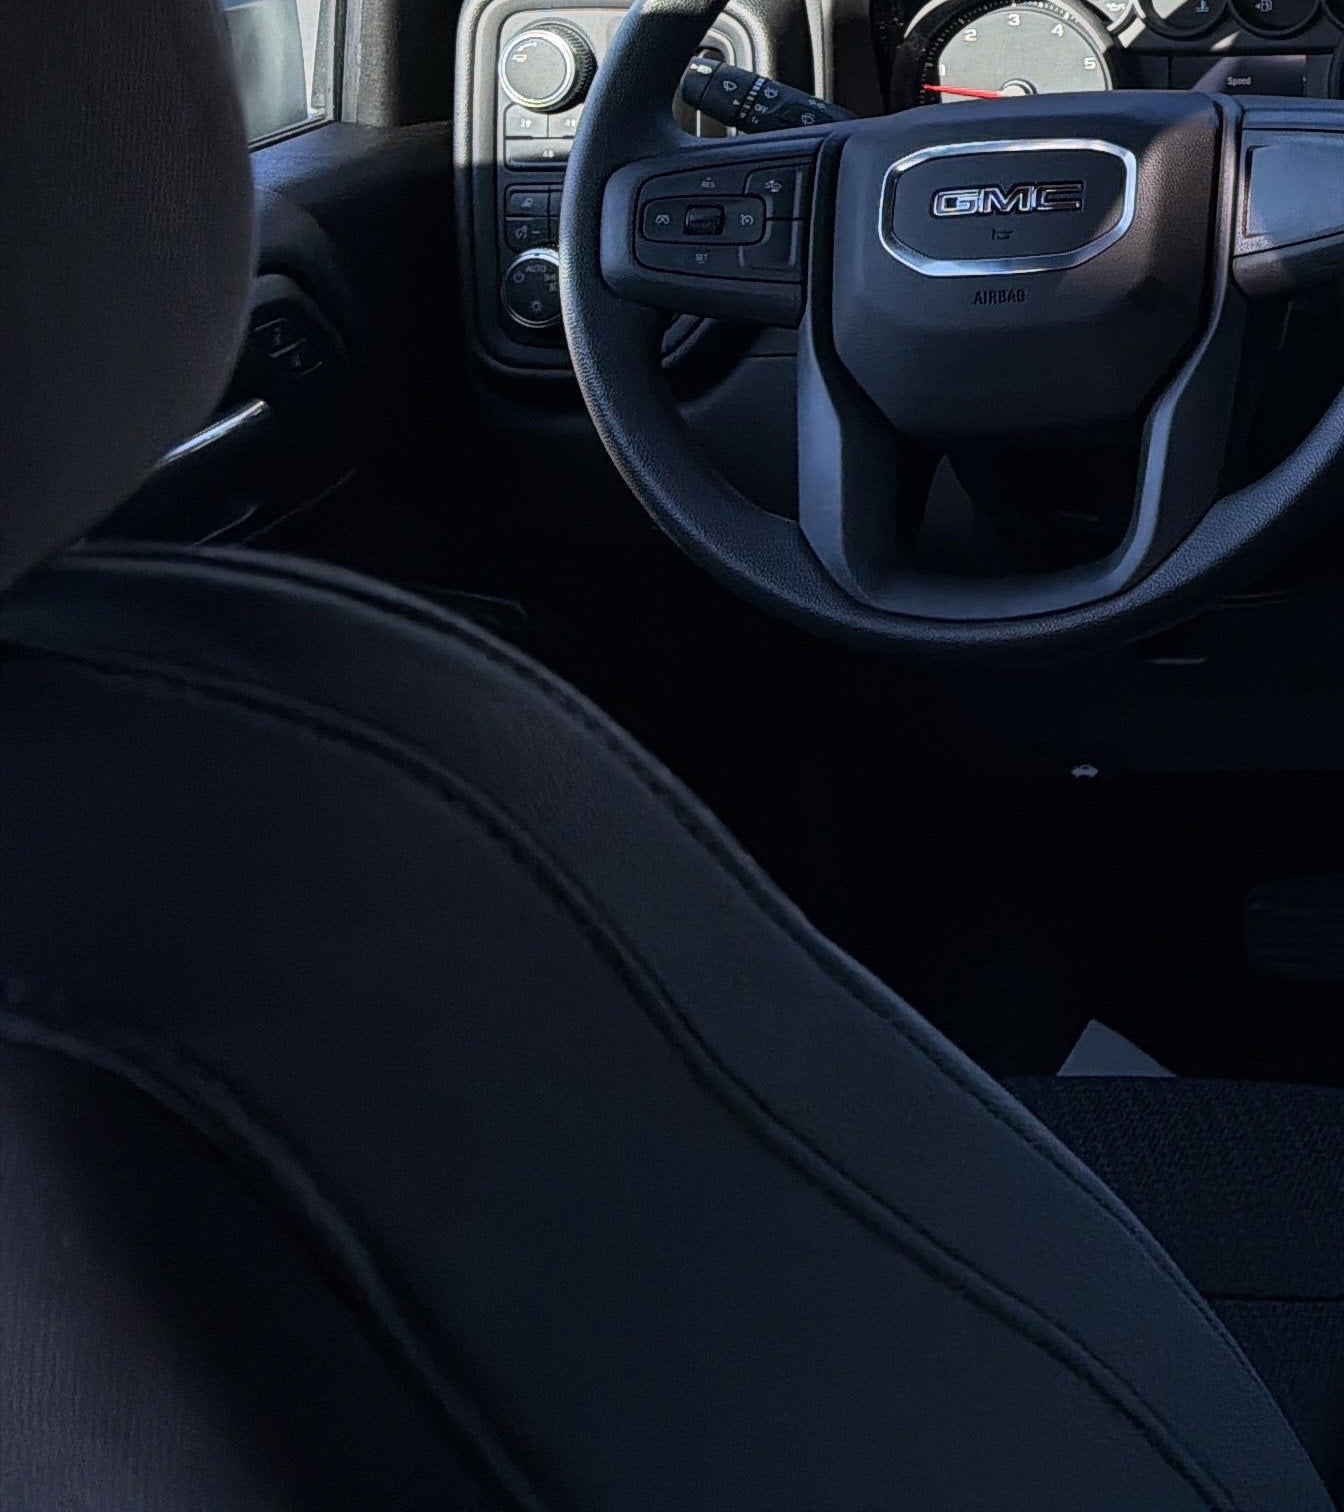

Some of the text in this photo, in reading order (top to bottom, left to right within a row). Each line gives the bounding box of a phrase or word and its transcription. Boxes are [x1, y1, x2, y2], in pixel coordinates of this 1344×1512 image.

[1007, 12, 1021, 27] 3
[963, 28, 978, 42] 2
[1052, 24, 1065, 37] 4
[938, 63, 946, 77] 1
[1084, 57, 1097, 70] 5
[1227, 75, 1252, 87] Speed
[931, 180, 1085, 219] GMC
[973, 288, 1025, 305] AIRBAG
